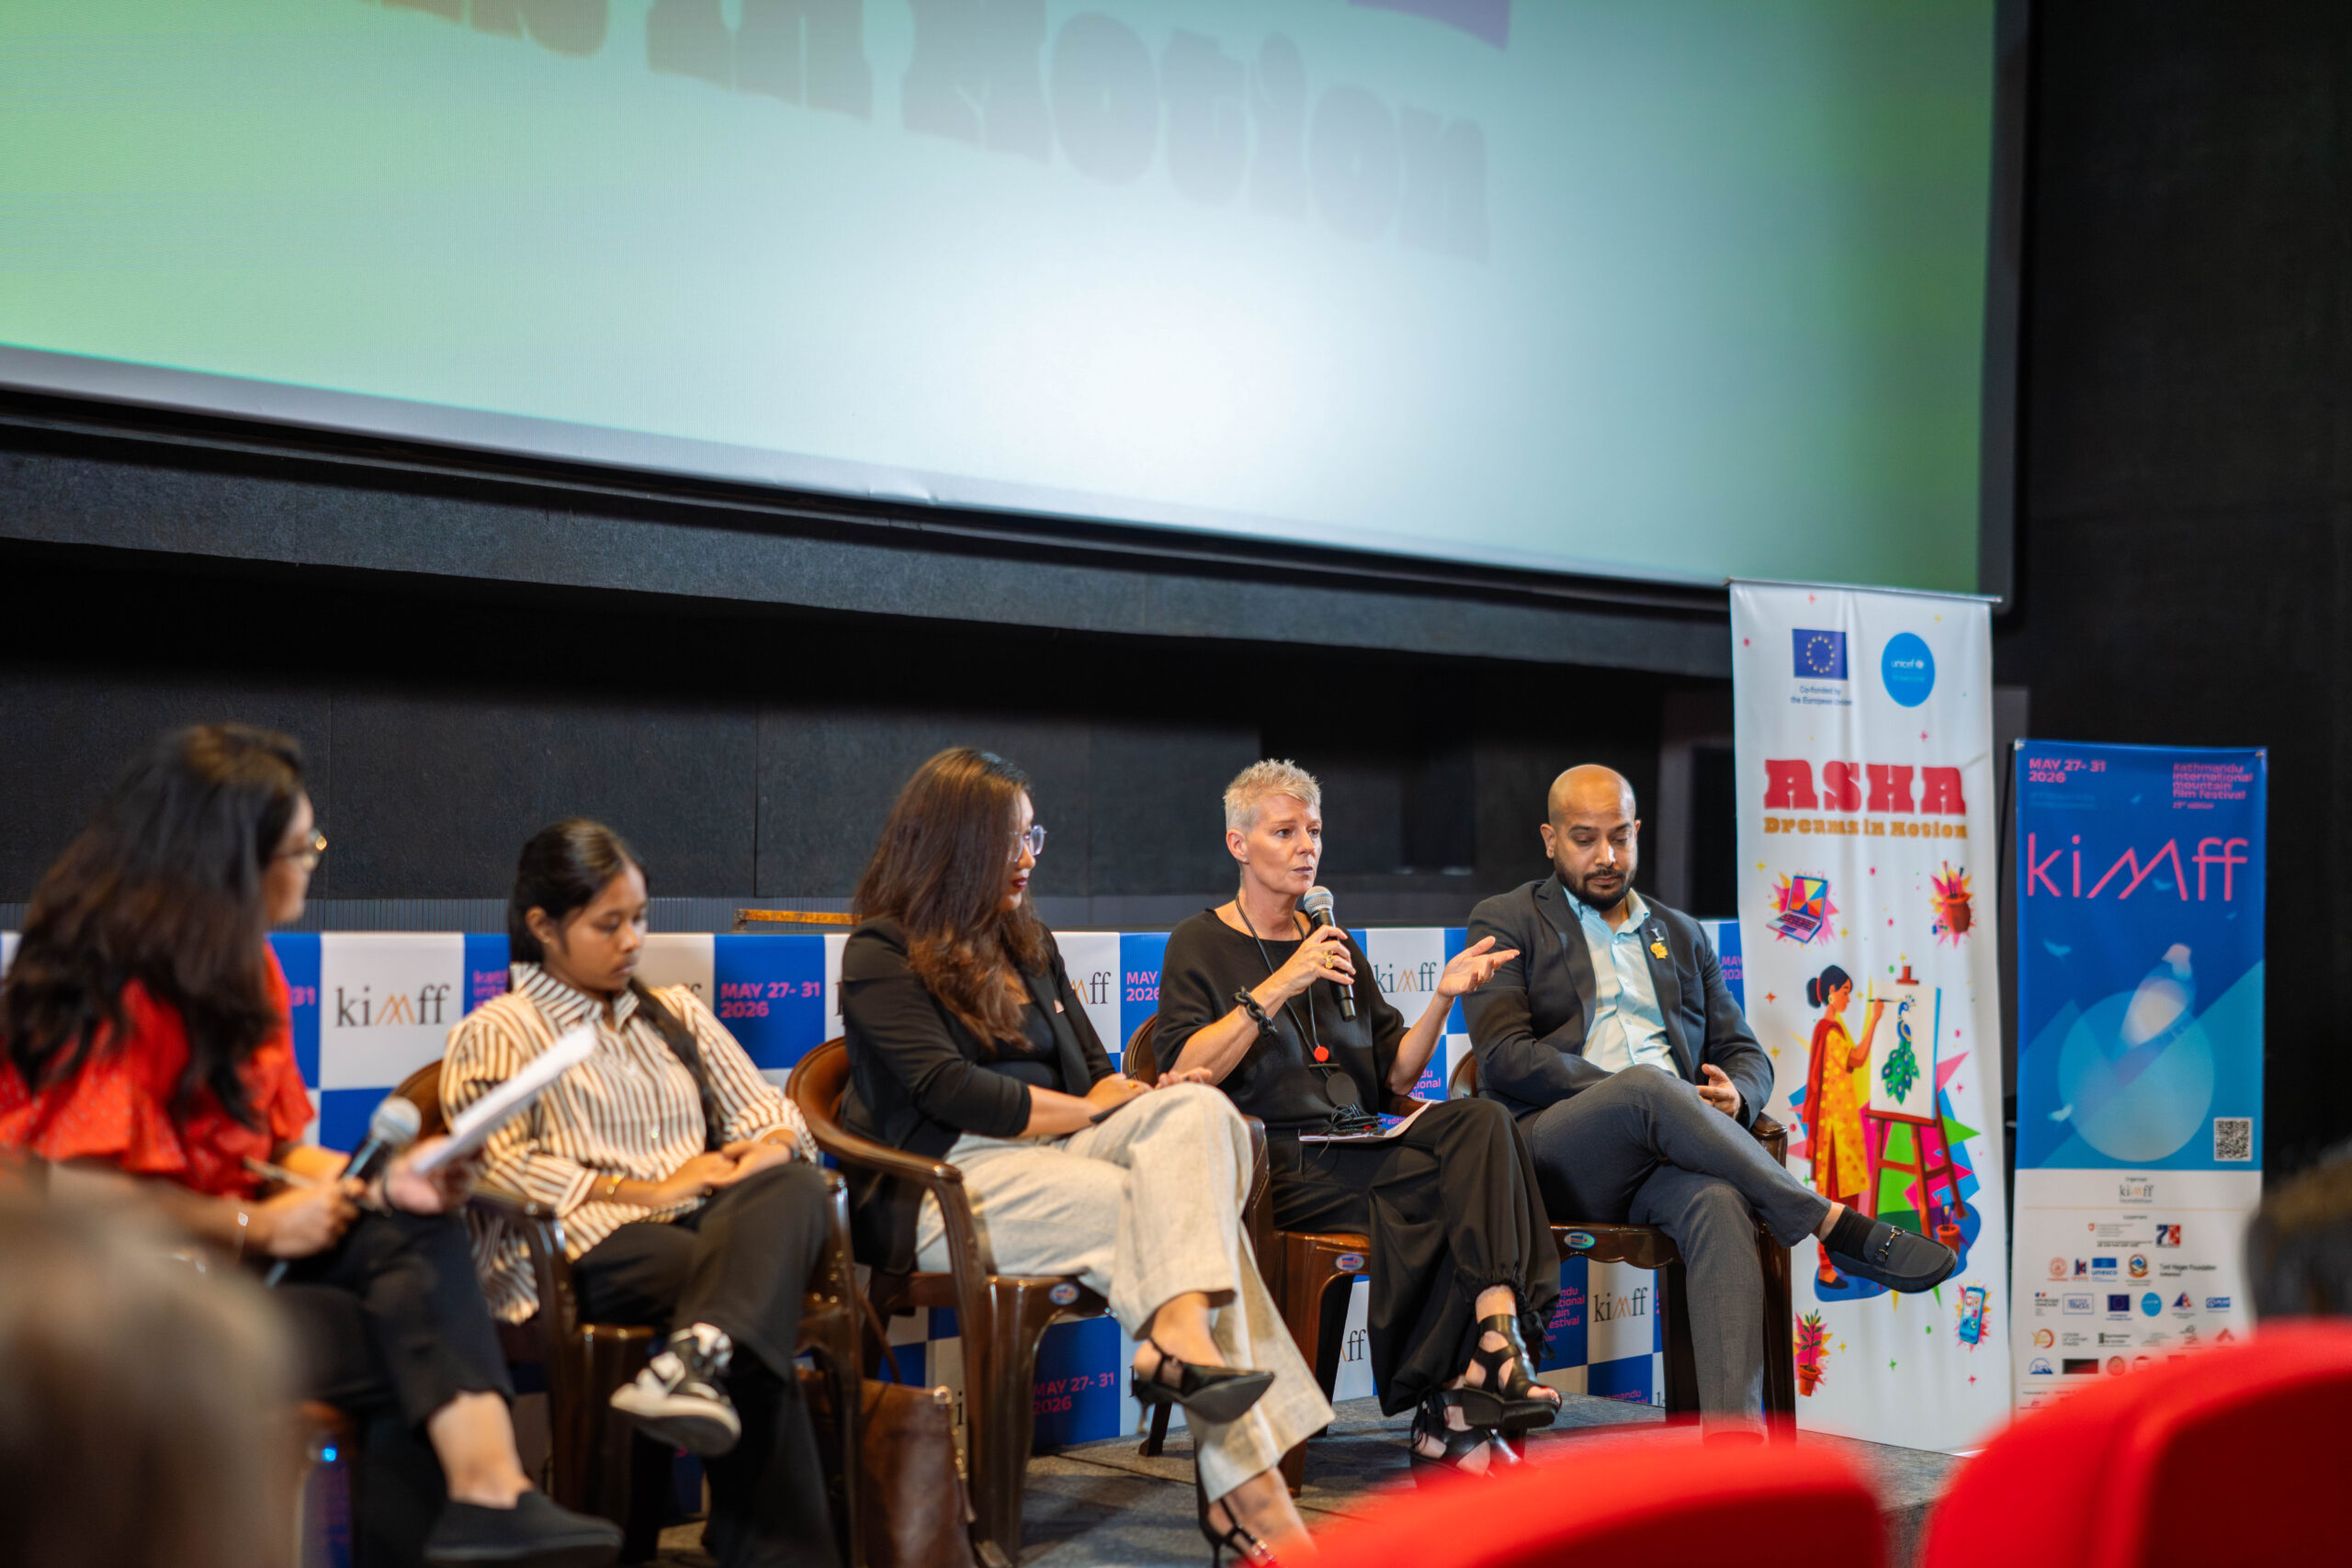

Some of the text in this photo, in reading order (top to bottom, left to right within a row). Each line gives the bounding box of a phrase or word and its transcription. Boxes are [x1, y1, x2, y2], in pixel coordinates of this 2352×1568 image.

[2029, 758, 2106, 772] MAY 27- 31
[2028, 771, 2066, 783] 2026
[2172, 772, 2253, 782] international
[1764, 760, 1966, 815] ASHA
[2172, 780, 2233, 790] mountain
[2172, 789, 2246, 799] film festival
[1764, 817, 1967, 839] Dreams in Motion
[1126, 971, 1158, 985] MAY
[720, 983, 763, 999] MAY
[767, 982, 797, 998] 27-
[801, 982, 820, 998] 31
[720, 1001, 769, 1018] 2026
[1549, 1315, 1579, 1328] estival
[1034, 1372, 1114, 1396] MAY 27- 31
